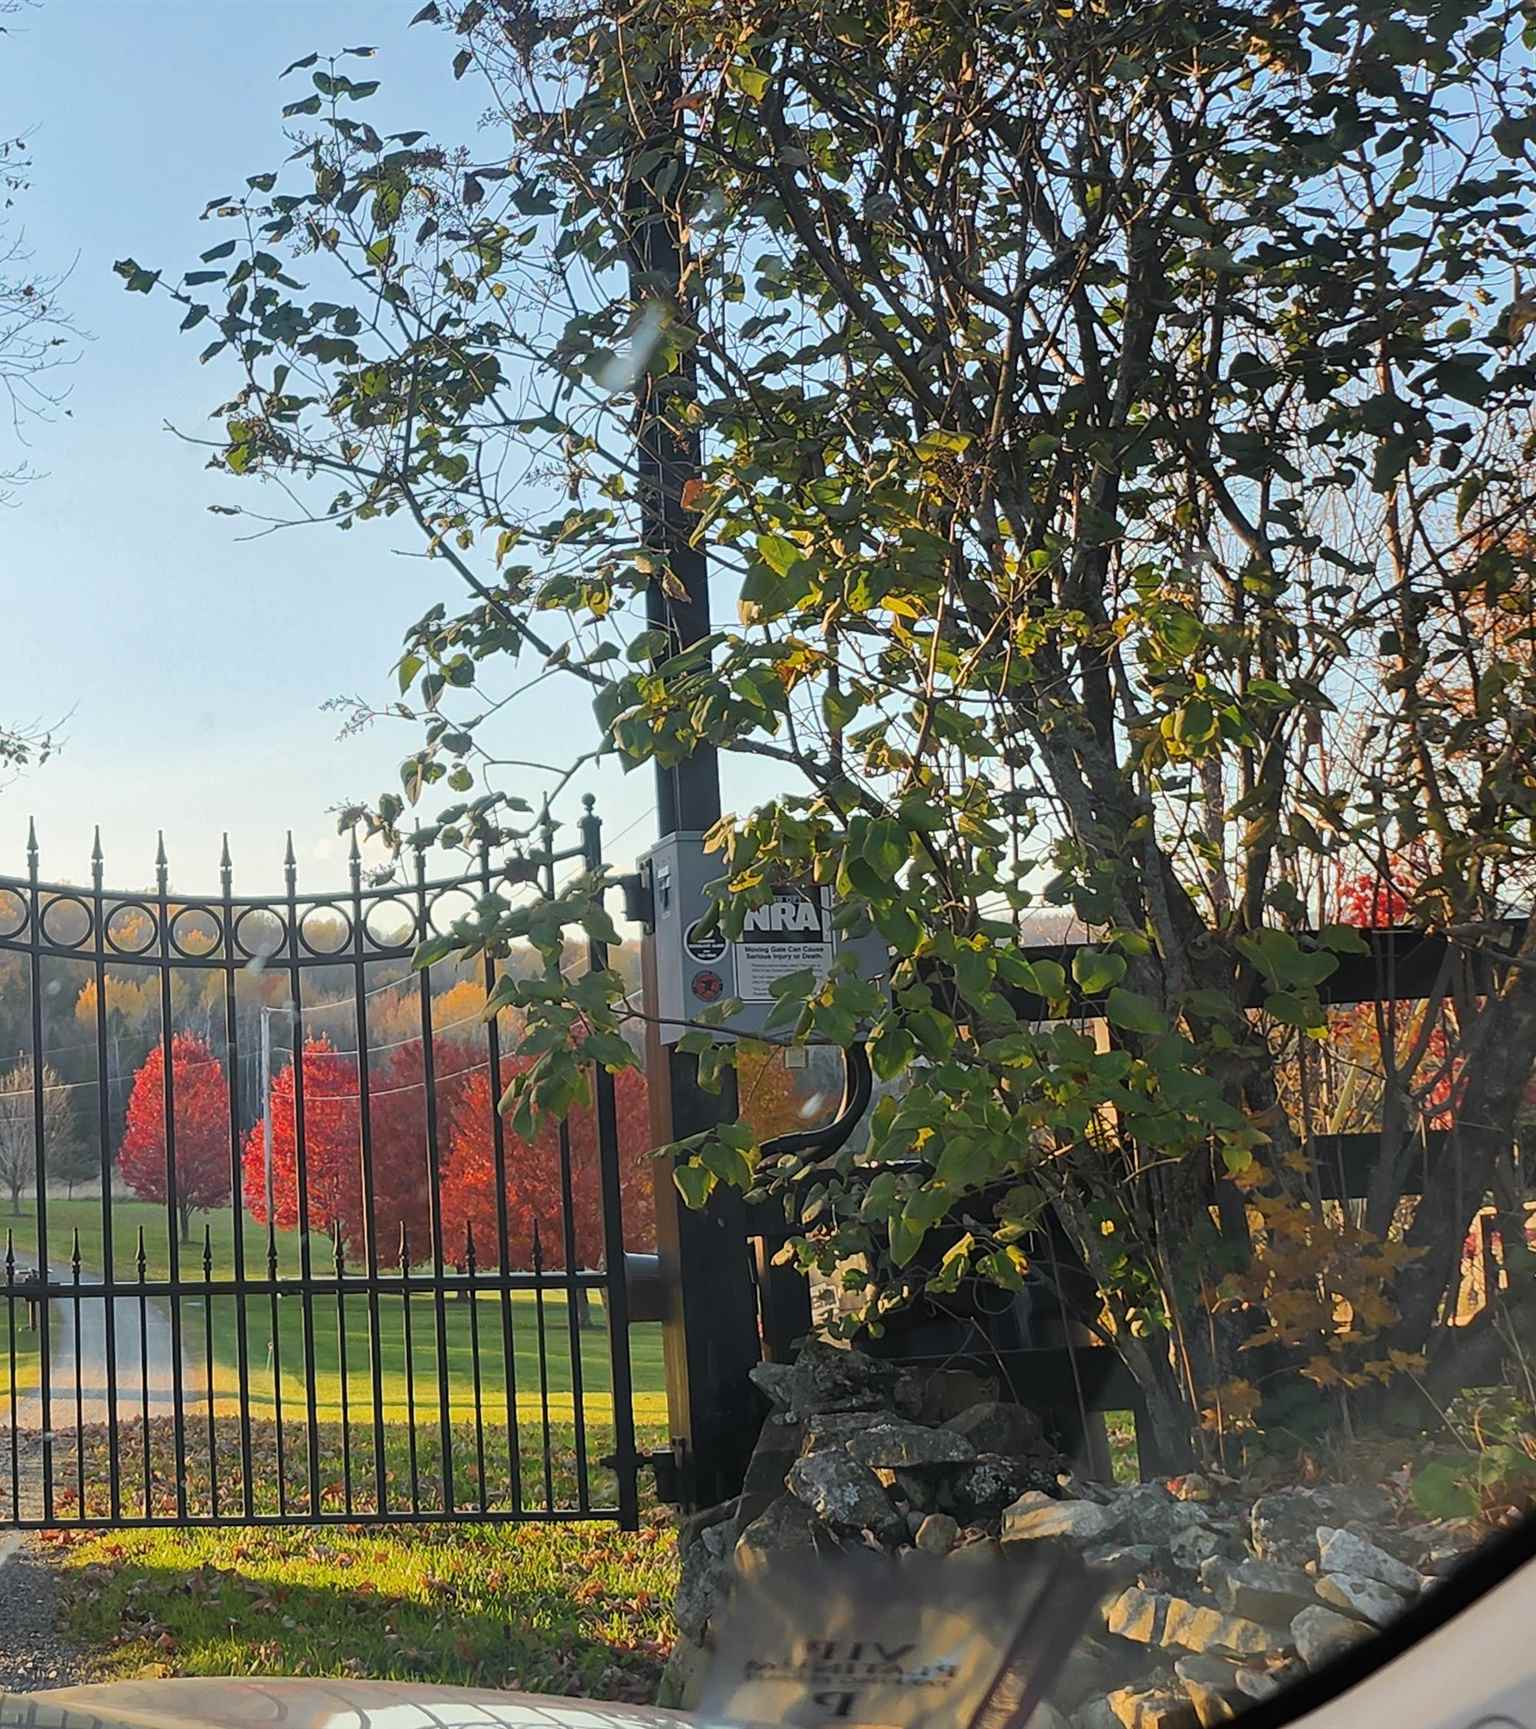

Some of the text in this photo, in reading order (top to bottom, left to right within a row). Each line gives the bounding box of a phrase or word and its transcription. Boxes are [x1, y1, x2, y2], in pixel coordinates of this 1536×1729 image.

[744, 902, 821, 931] NRA
[744, 945, 769, 954] Moving
[788, 945, 801, 953] Can
[803, 945, 824, 953] Cause
